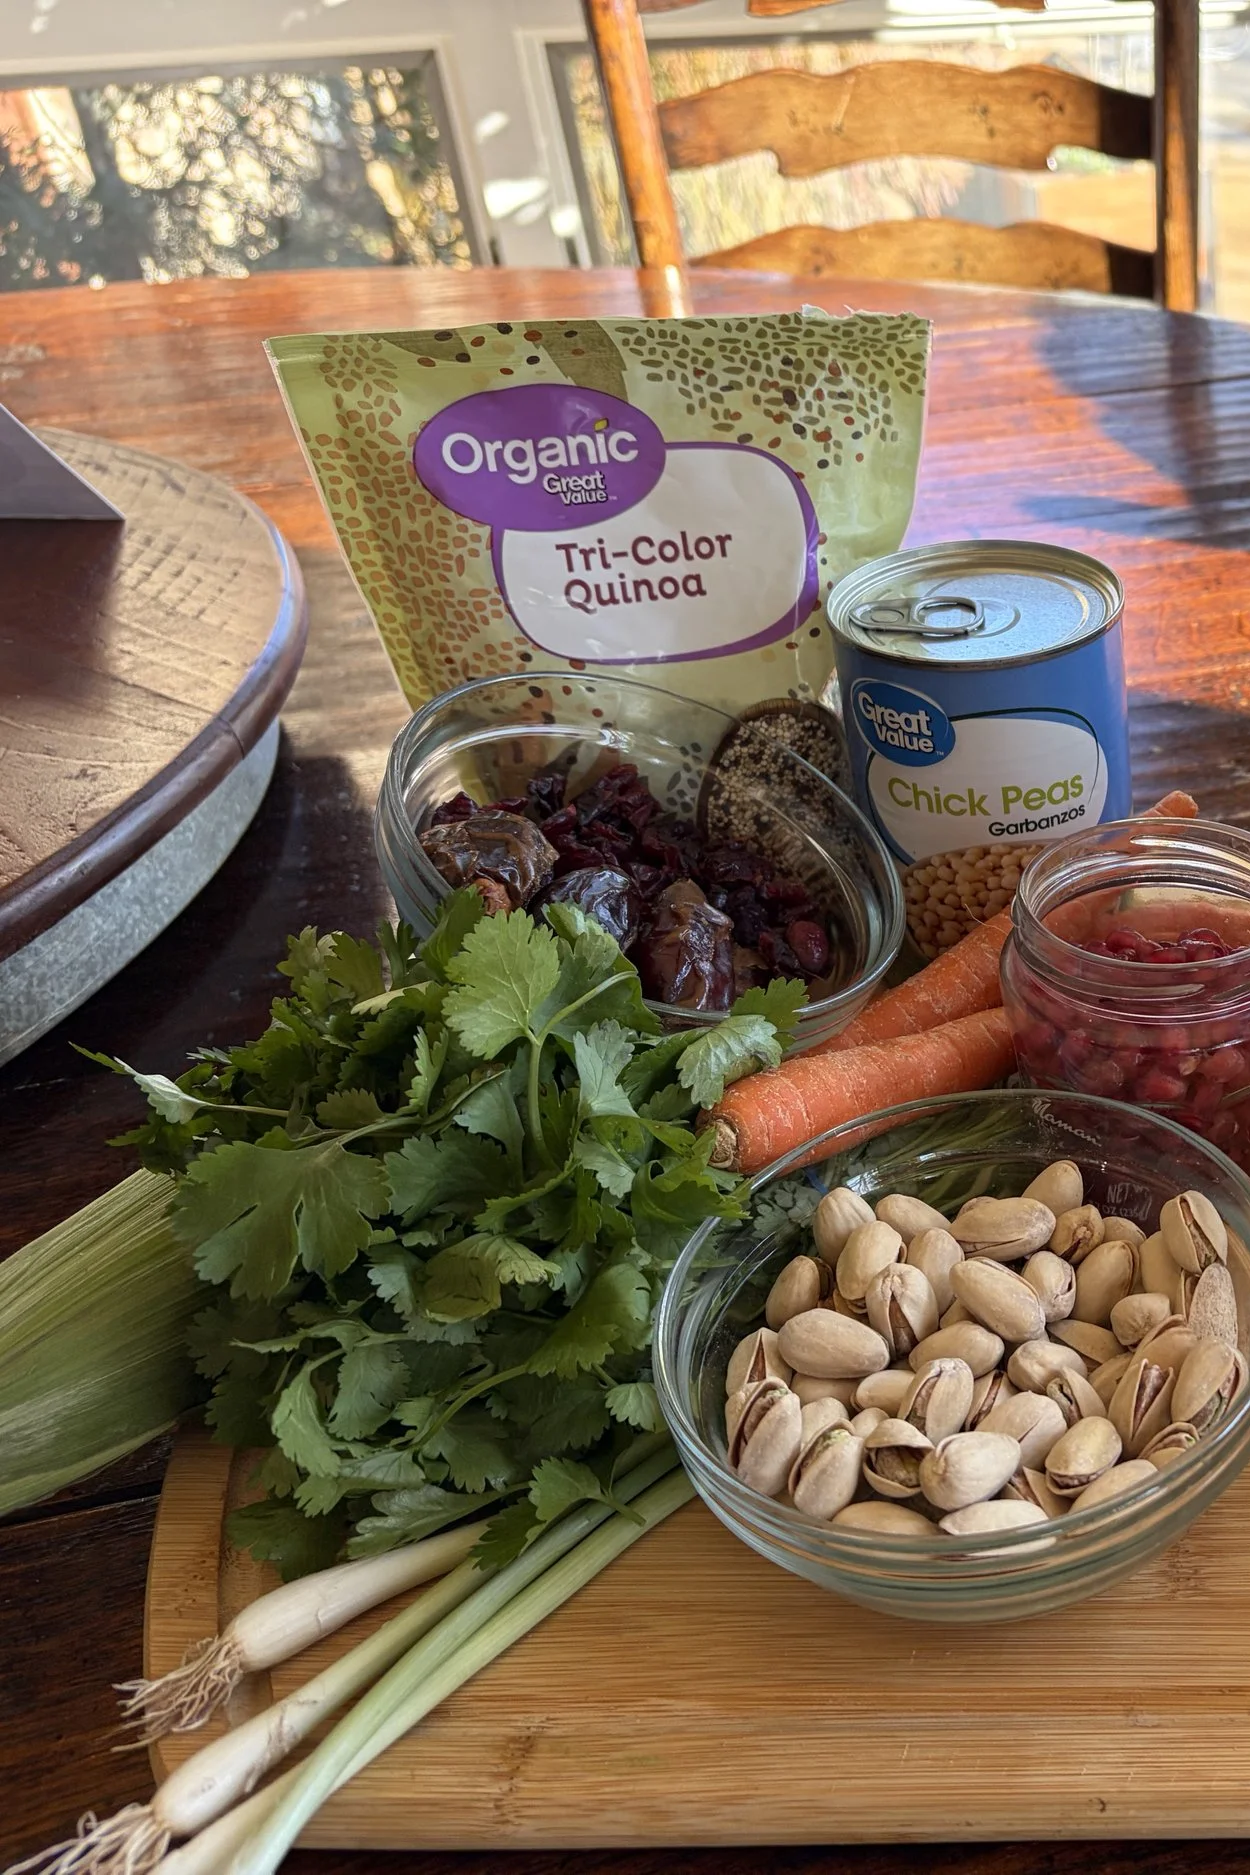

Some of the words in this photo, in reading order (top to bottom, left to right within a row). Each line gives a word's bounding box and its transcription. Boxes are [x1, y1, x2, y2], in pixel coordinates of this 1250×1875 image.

[441, 418, 639, 484] Organic
[542, 470, 606, 495] Great
[560, 489, 608, 506] Value
[555, 530, 733, 574] Tri-Color
[563, 572, 708, 615] Quinoa
[858, 691, 933, 737] Great
[873, 721, 935, 754] Value
[888, 776, 992, 817] Chick
[1001, 774, 1085, 815] Peas
[988, 804, 1086, 837] Garbanzos
